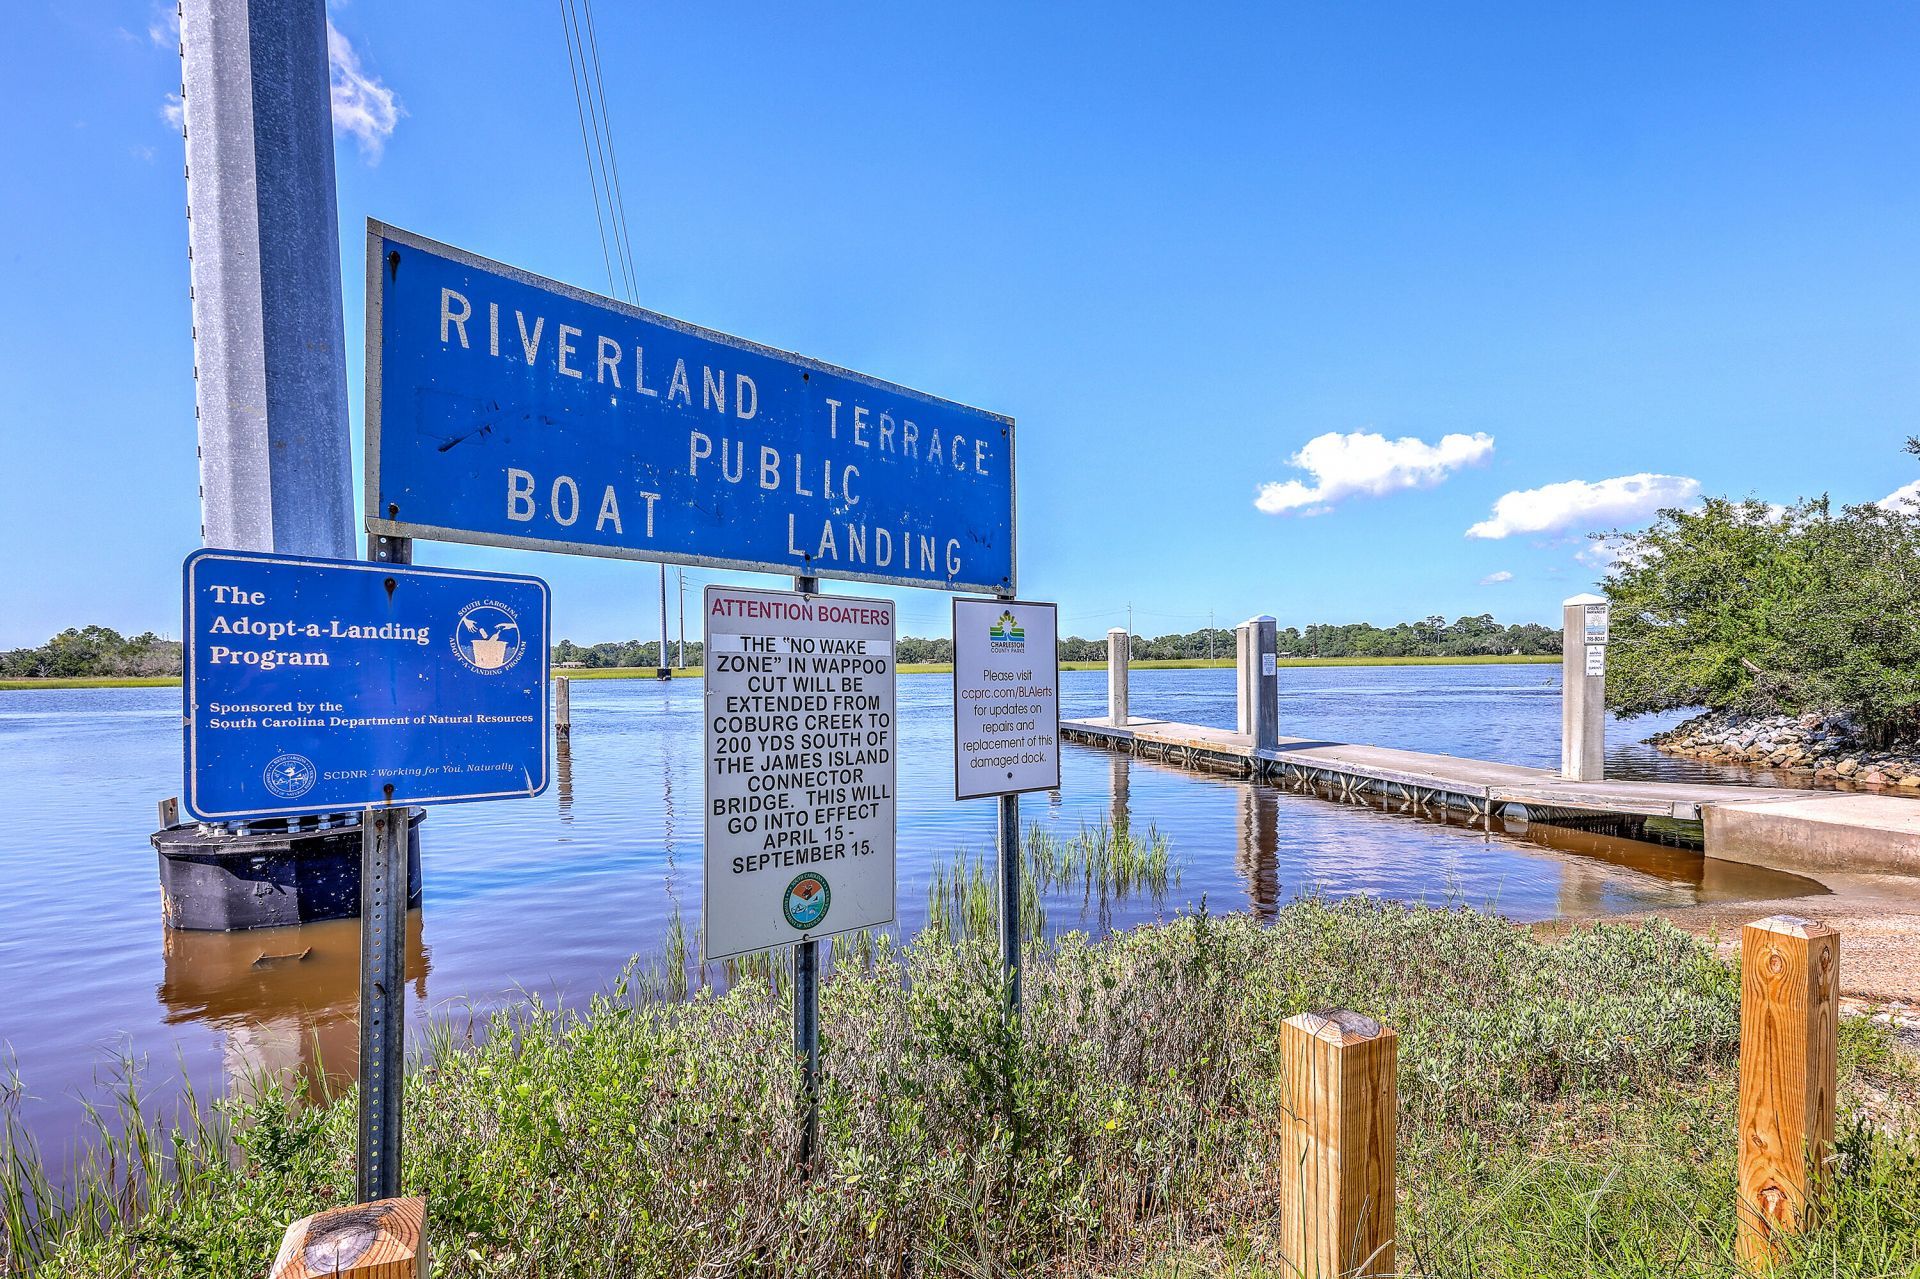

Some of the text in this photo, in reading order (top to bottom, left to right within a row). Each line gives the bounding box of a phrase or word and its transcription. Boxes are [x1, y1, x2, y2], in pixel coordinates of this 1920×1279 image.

[438, 287, 990, 477] RIVERLAND TERRACE
[690, 431, 861, 505] PUBLIC
[507, 467, 961, 576] BOAT LANDING
[209, 584, 266, 606] The
[458, 599, 519, 619] SOUTH CAROLINA
[712, 598, 890, 626] ATTENTION BOATERS
[209, 616, 430, 646] Adopt-a-Landing
[740, 636, 776, 652] THE
[820, 640, 866, 654] WAKE
[209, 646, 330, 670] Program
[449, 637, 527, 676] ADOPT-A-LANDING PROGRAM
[788, 658, 806, 673] IN
[813, 658, 886, 674] WAPPOO
[748, 676, 863, 693] CUT WILL BE
[983, 669, 1032, 681] Please visit
[961, 685, 1052, 700] ccprc.com/BLAlerts
[210, 702, 343, 715] Sponsored by the
[727, 696, 880, 713] EXTENDED FROM
[974, 704, 1041, 718] for updates on
[210, 714, 534, 729] South Carolina Department of Natural Resources
[714, 713, 890, 734] COBURG CREEK TO
[982, 719, 1034, 734] repairs and
[716, 731, 888, 754] 200 YDS SOUTH OF
[963, 734, 1052, 752] replacement of this
[714, 749, 889, 774] THE JAMES ISLAND
[970, 751, 1047, 768] damaged dock.
[324, 770, 367, 780] SCDNR
[378, 768, 421, 777] Working
[422, 766, 439, 777] for
[467, 762, 514, 773] Naturally
[748, 768, 864, 792] CONNECTOR
[713, 784, 890, 816] BRIDGE. THIS WILL
[728, 803, 879, 834] GO INTO EFFECT
[763, 829, 818, 850] APRIL
[824, 825, 843, 842] 15
[732, 840, 874, 874] SEPTEMBER 15.
